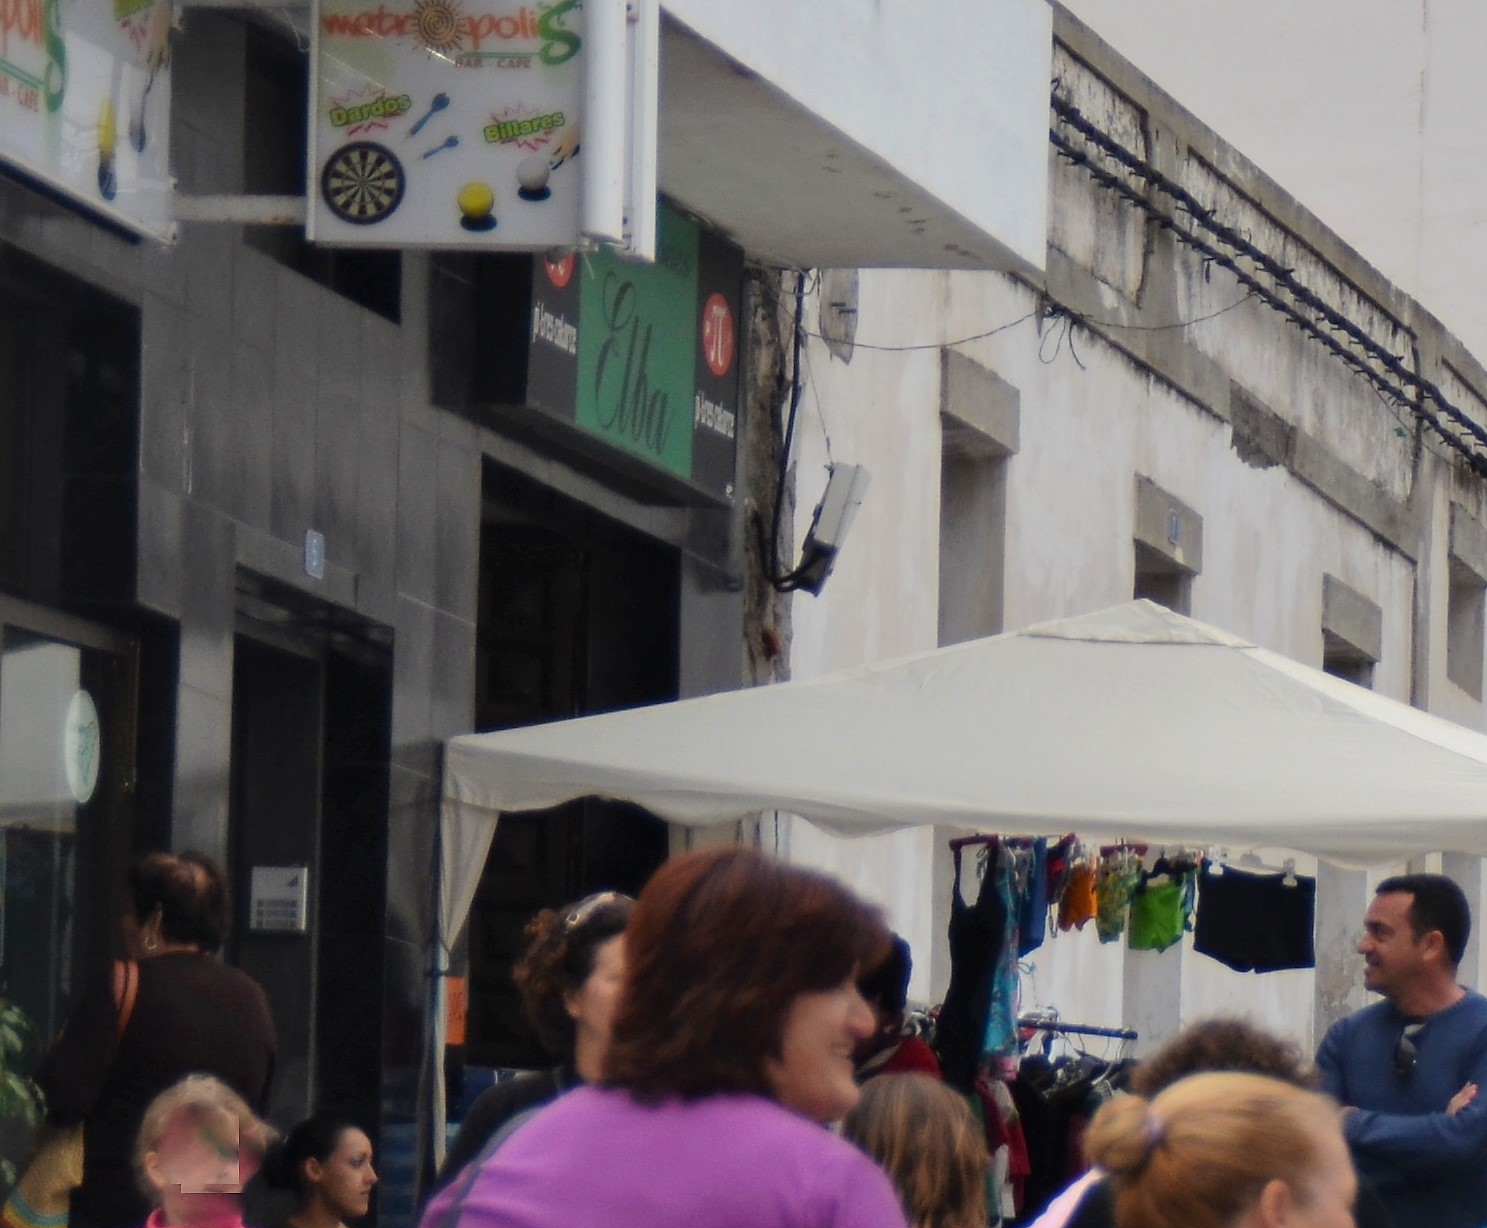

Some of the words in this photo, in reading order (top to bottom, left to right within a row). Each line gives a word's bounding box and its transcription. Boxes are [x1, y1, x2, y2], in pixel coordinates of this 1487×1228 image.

[454, 57, 483, 69] BAR
[329, 94, 412, 127] Dardos
[483, 112, 566, 144] Billares
[594, 270, 675, 456] Elba
